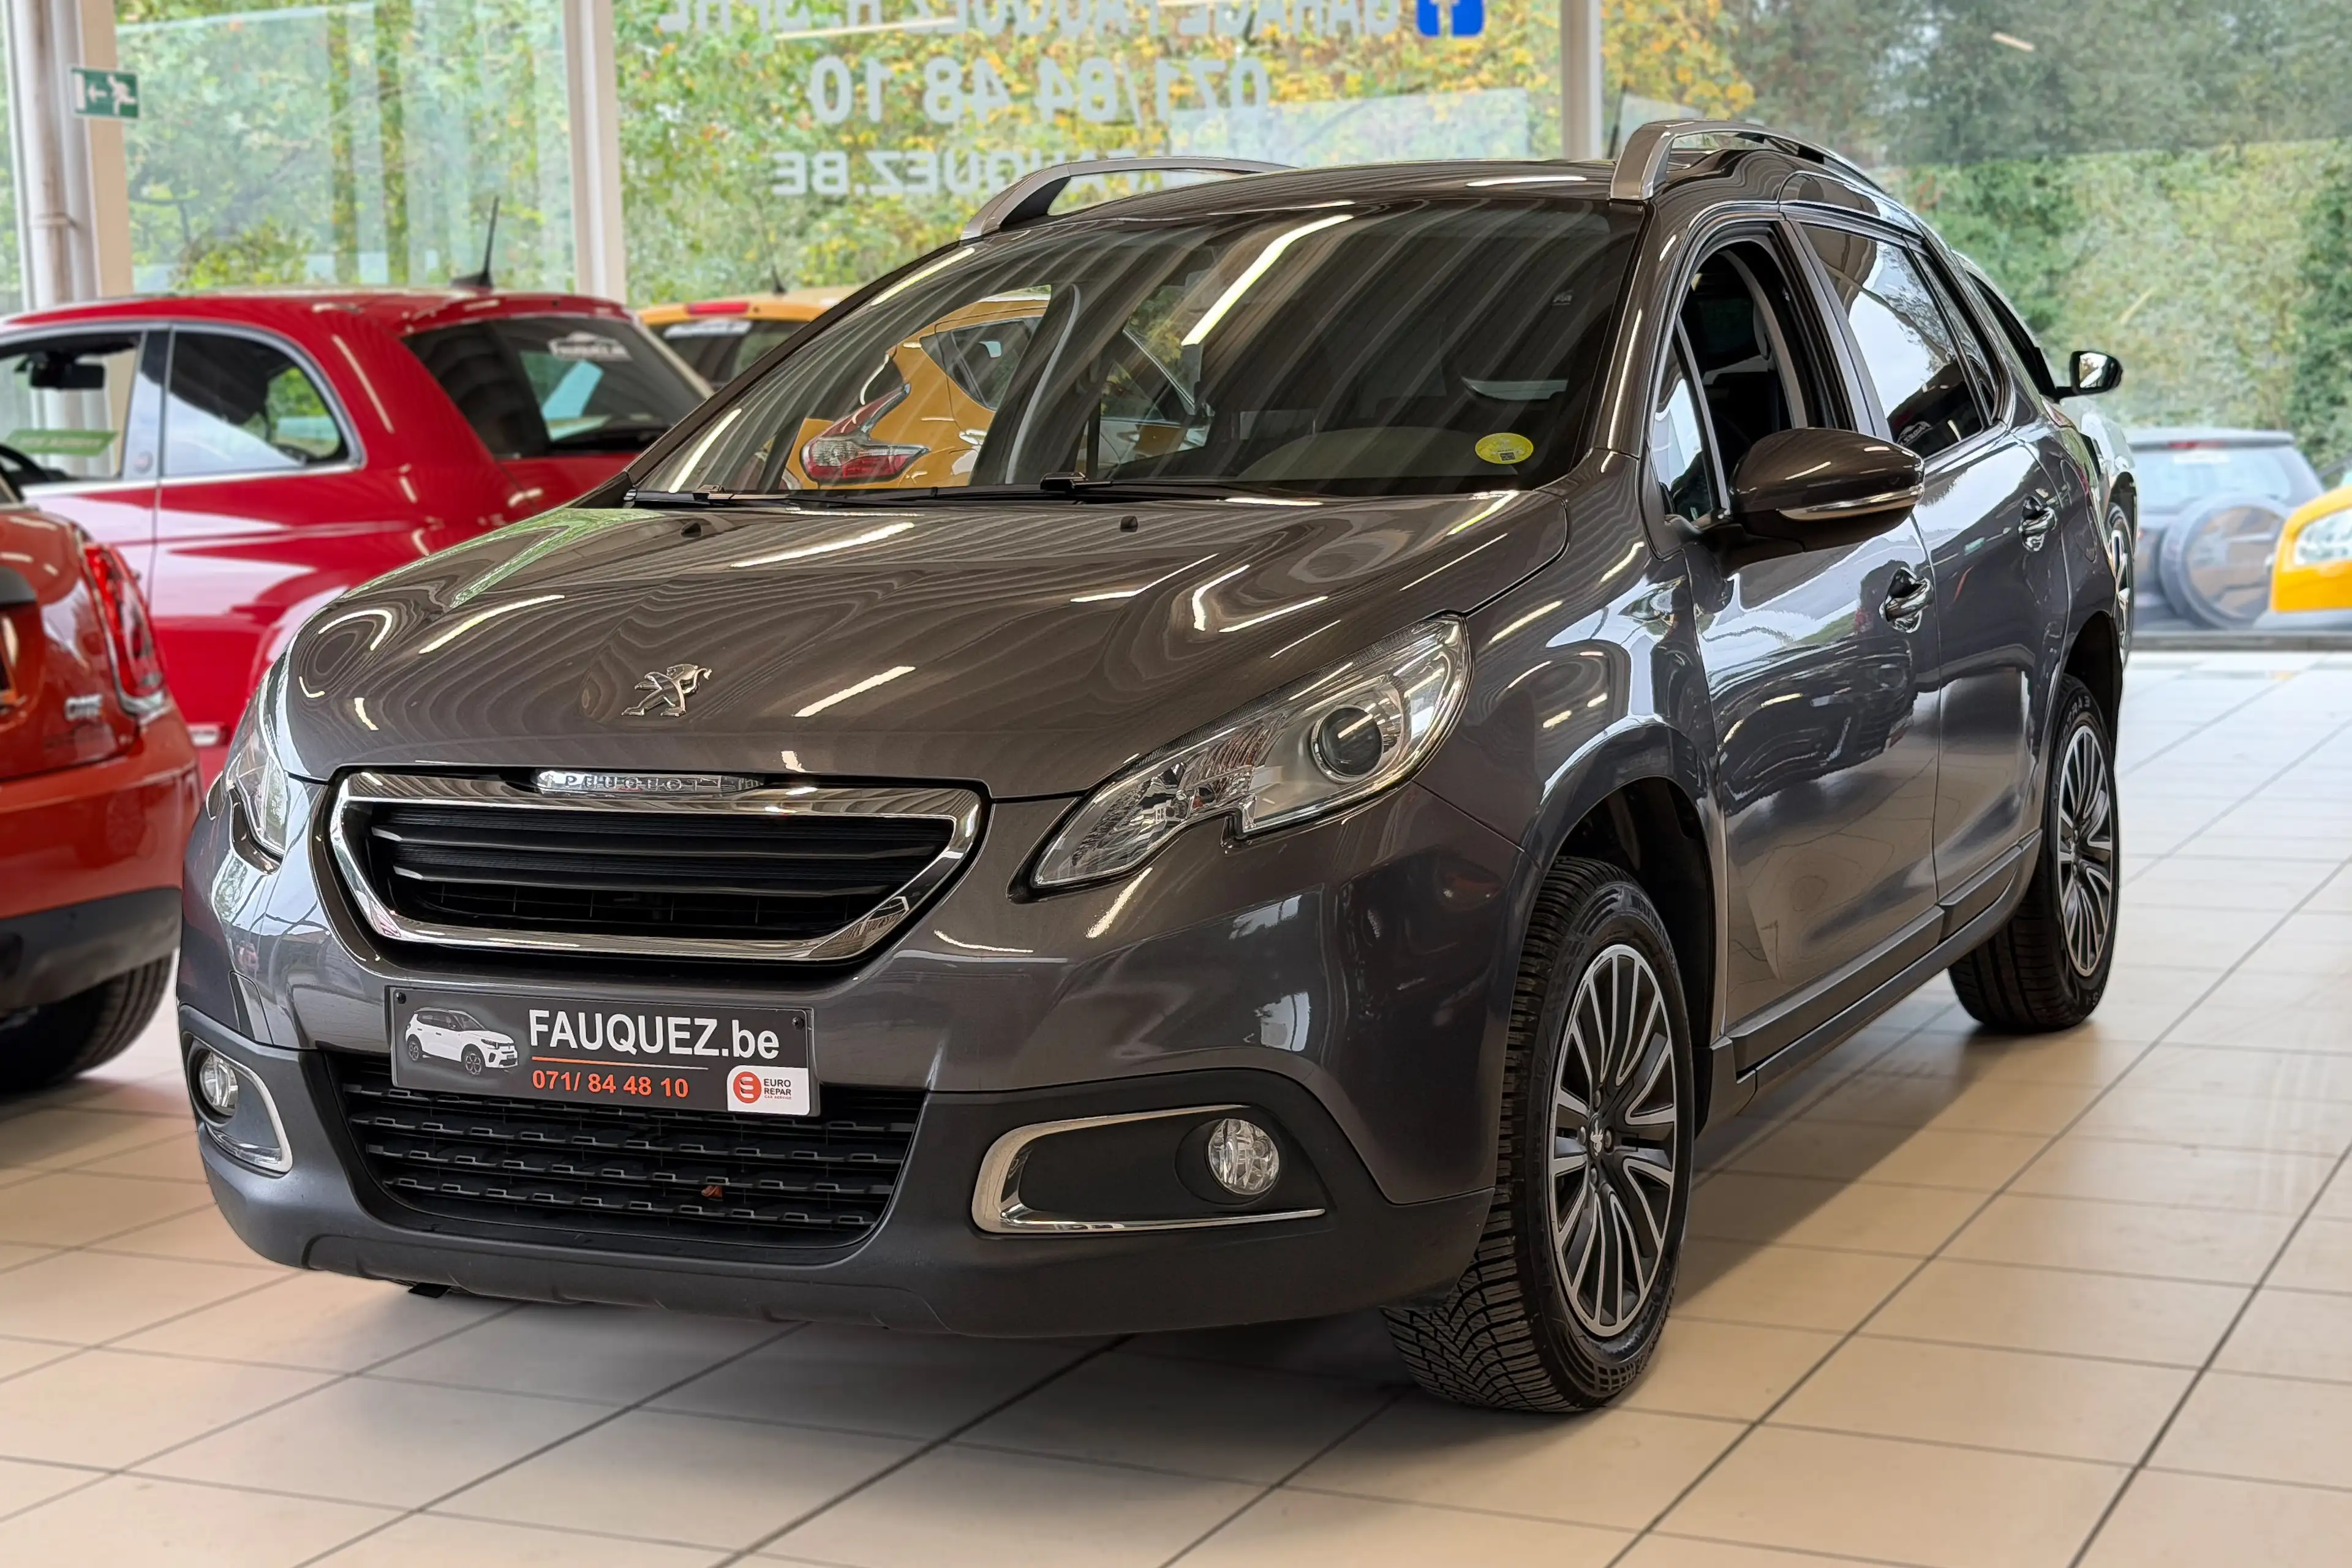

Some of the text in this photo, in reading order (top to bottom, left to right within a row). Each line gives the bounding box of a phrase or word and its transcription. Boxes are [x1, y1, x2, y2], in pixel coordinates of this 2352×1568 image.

[529, 1009, 780, 1059] FAUQUEZ.be
[532, 1070, 688, 1098] 071/ 84 48 10
[764, 1078, 791, 1088] EURO
[764, 1087, 791, 1096] REPAR
